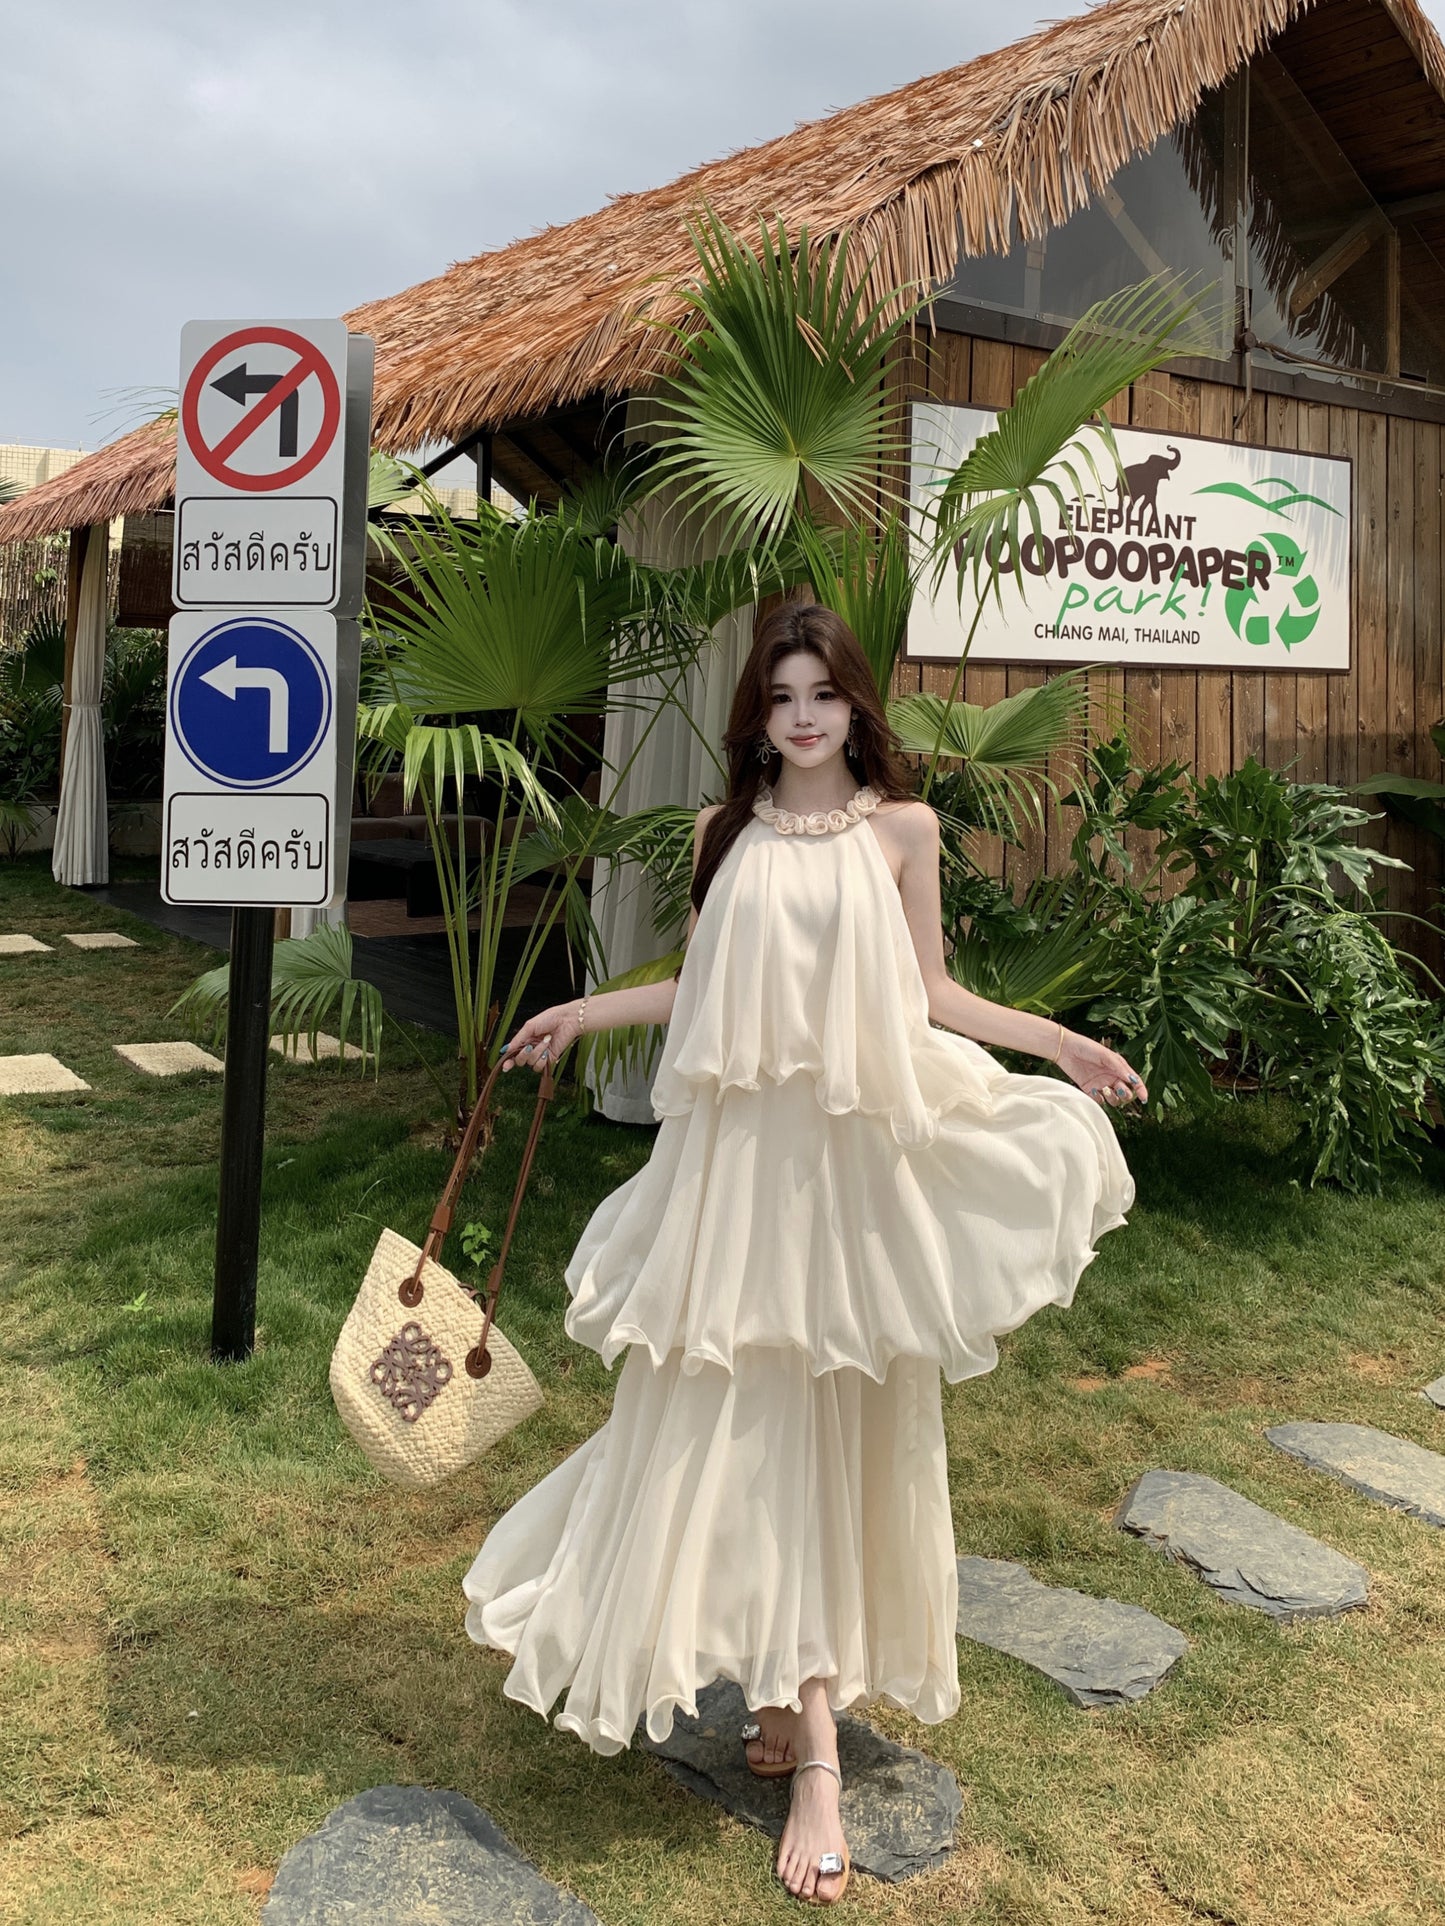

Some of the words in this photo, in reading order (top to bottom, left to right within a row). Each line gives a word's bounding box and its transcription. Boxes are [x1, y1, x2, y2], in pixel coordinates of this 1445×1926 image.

[1058, 503, 1197, 541] ELEPHANT
[182, 530, 331, 571] สวัสดีครับ
[1054, 562, 1213, 637] park!
[1033, 623, 1094, 641] CHIANG
[1098, 626, 1129, 645] MAI,
[1134, 628, 1201, 645] THAILAND
[172, 827, 323, 870] สวัสดีครับ
